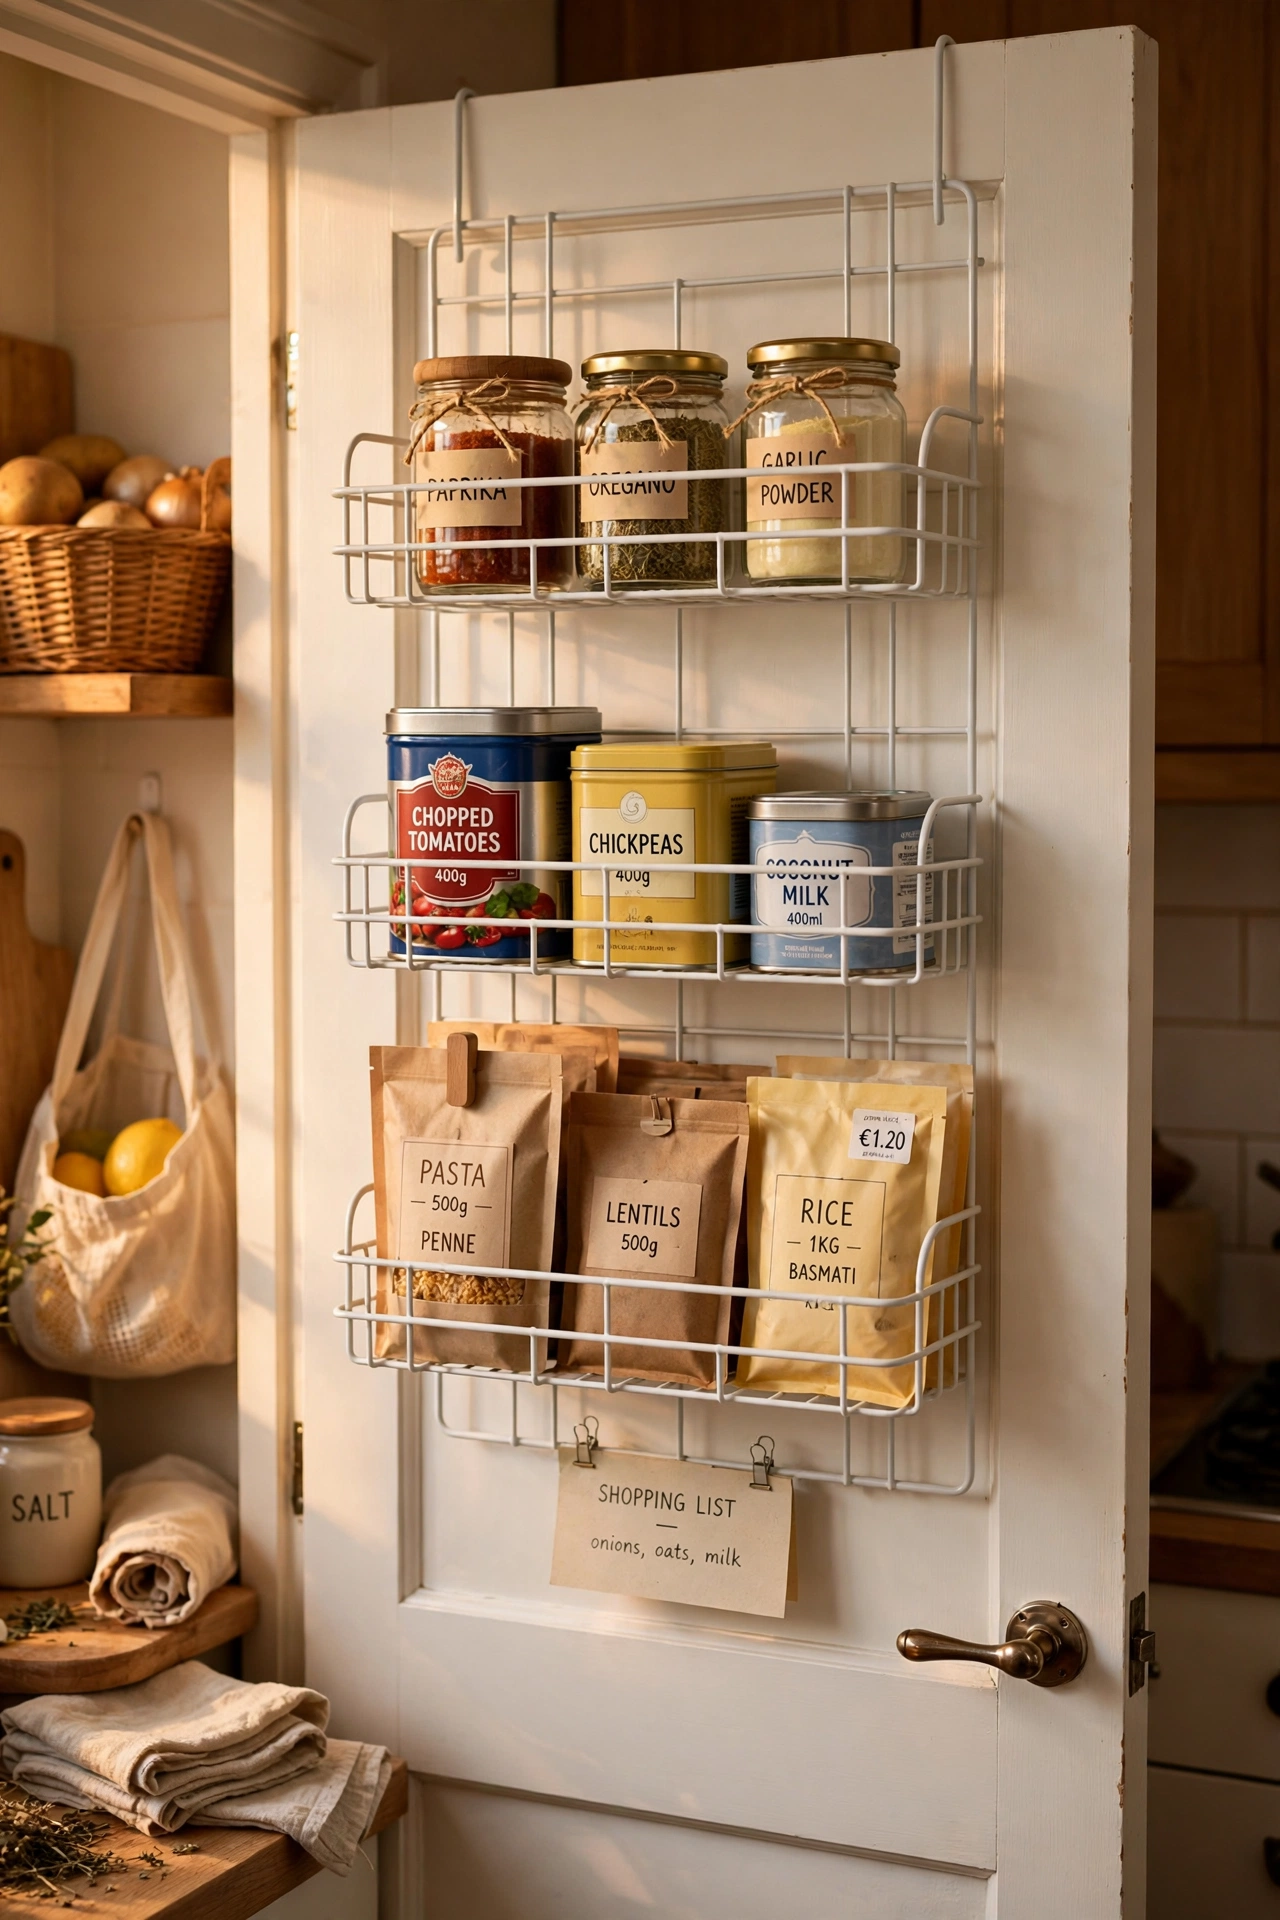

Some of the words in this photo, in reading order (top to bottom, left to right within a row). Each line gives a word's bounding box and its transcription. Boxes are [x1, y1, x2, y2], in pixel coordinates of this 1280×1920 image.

[762, 450, 827, 468] GARLIC
[427, 477, 507, 502] PAPRIKA
[589, 470, 675, 496] OREGANO
[761, 481, 834, 506] POWDER
[411, 806, 494, 828] CHOPPED
[407, 830, 501, 853] TOMATOES
[589, 832, 684, 855] CHICKPEAS
[434, 868, 467, 887] 400g
[615, 870, 650, 887] 400g
[766, 858, 854, 880] COCONUT
[782, 885, 830, 906] MILK
[786, 912, 823, 926] 400ml
[859, 1128, 906, 1151] €1.20
[420, 1159, 486, 1188] PASTA
[431, 1194, 468, 1218] 500g
[606, 1201, 681, 1228] LENTILS
[801, 1198, 854, 1227] RICE
[421, 1230, 476, 1254] PENNE
[621, 1233, 658, 1258] 500g
[809, 1234, 840, 1254] 1KG
[789, 1262, 856, 1285] BASMATI
[12, 1490, 75, 1522] SALT
[598, 1483, 686, 1512] SHOPPING
[696, 1495, 737, 1518] LIST
[590, 1534, 646, 1560] onions,
[655, 1543, 695, 1566] oats,
[705, 1547, 742, 1568] milk
